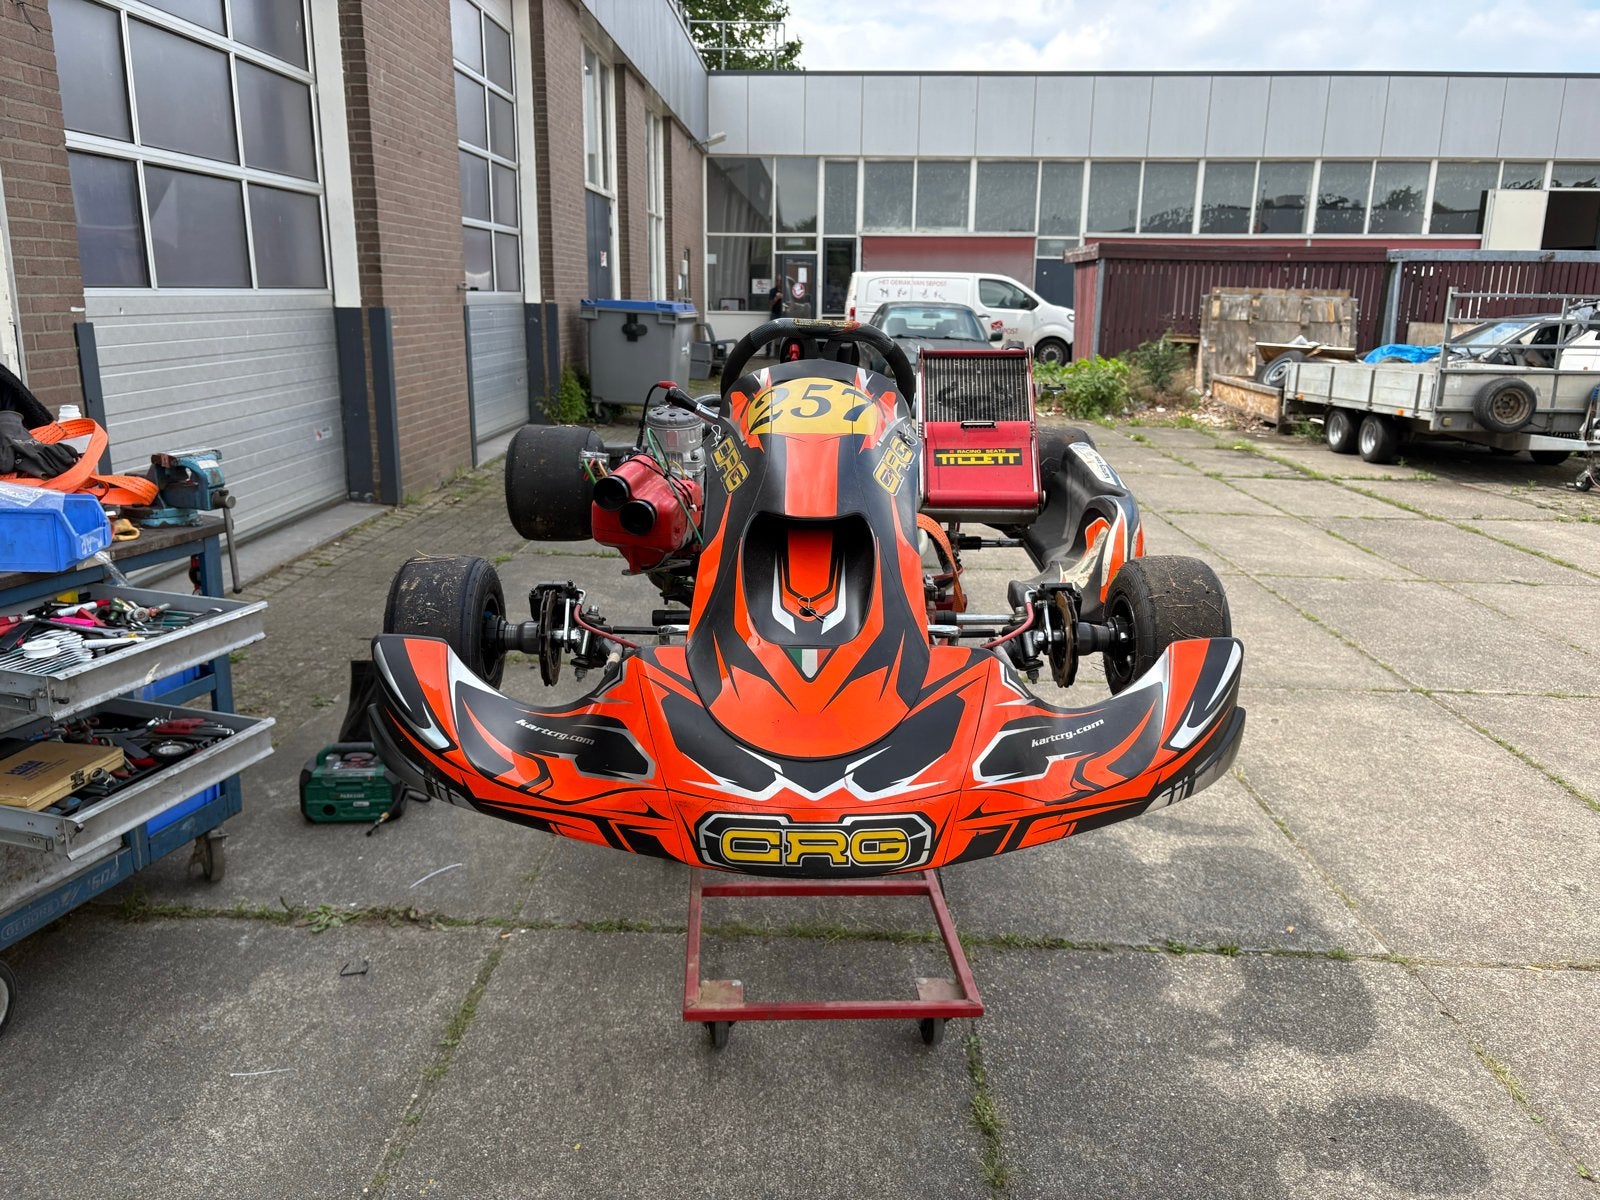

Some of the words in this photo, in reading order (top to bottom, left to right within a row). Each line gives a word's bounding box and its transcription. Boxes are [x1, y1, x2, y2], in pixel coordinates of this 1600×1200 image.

[749, 383, 874, 435] 257
[711, 436, 750, 495] CRG
[873, 436, 916, 496] CRG
[936, 453, 1020, 465] TILLETT
[515, 719, 596, 746] kartcrg.com
[1031, 718, 1105, 748] kartcrg.com
[720, 828, 909, 866] CRG
